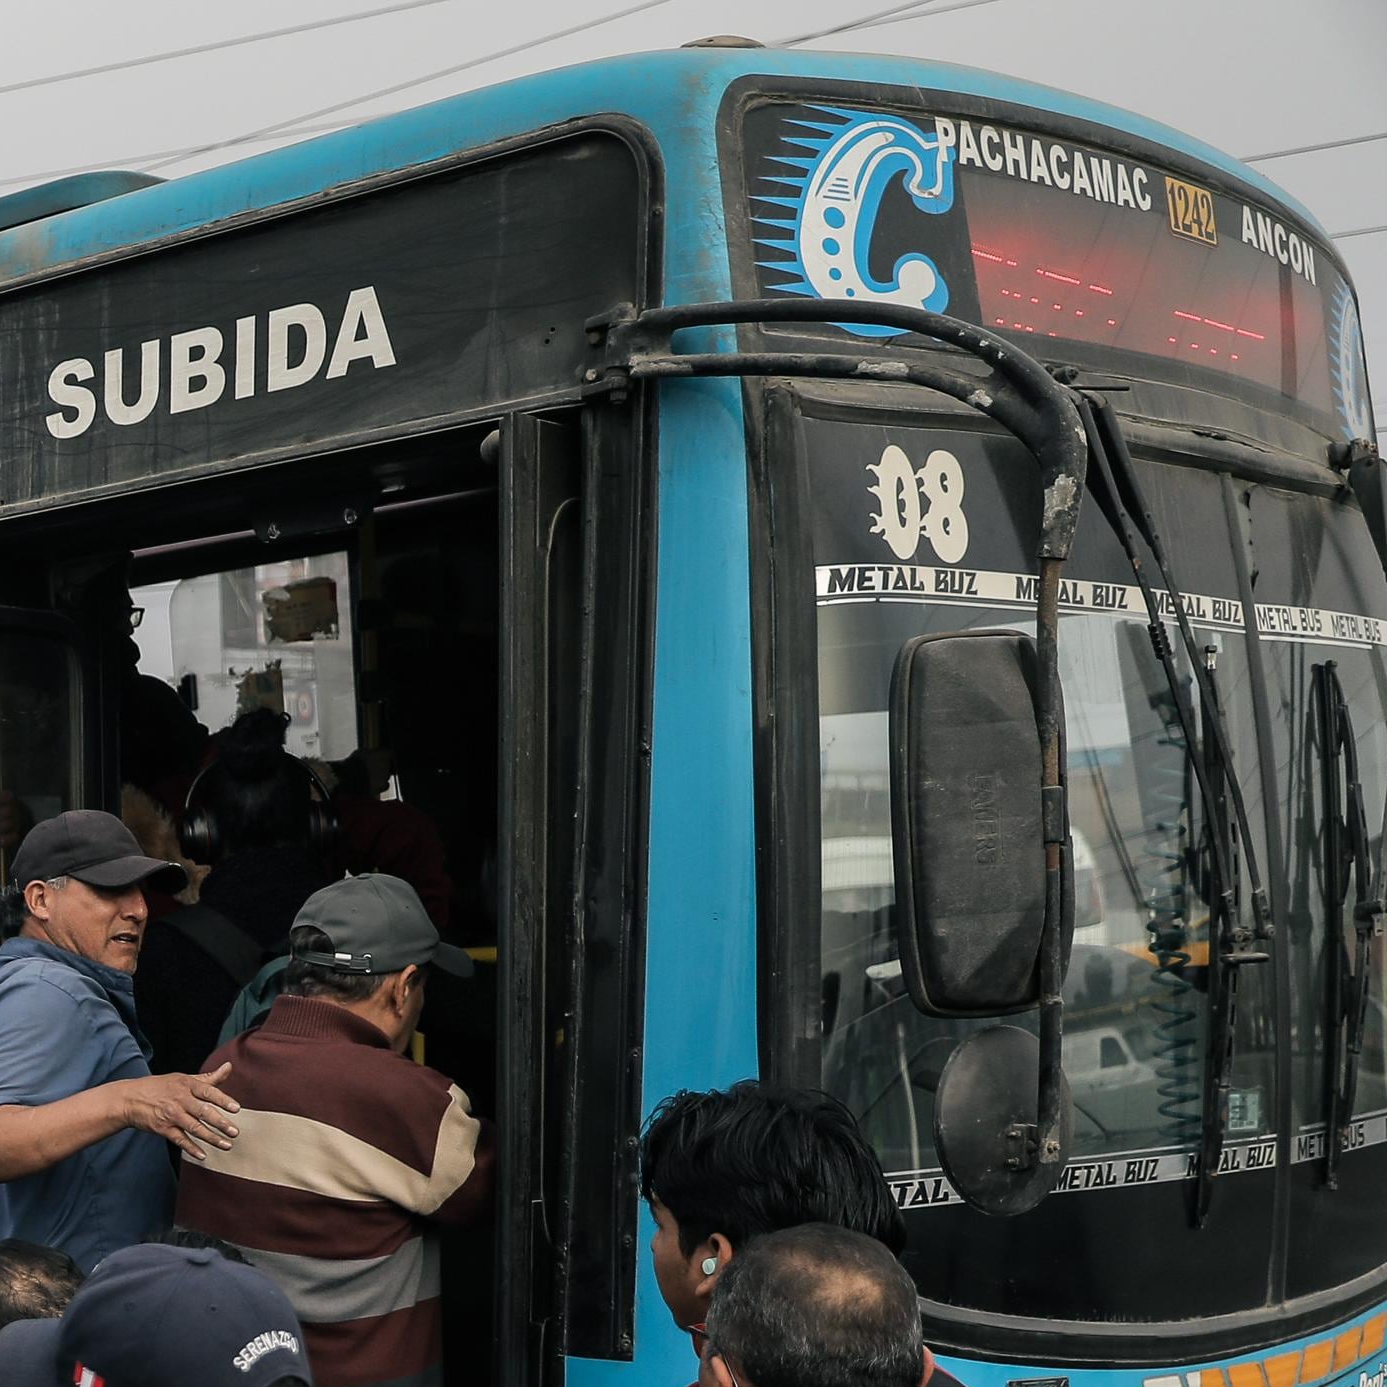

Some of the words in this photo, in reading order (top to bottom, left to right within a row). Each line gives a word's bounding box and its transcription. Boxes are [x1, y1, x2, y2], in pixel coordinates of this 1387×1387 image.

[935, 116, 1153, 212] PACHACAMAC
[1168, 182, 1216, 240] 1242
[1242, 205, 1318, 287] ANCON
[46, 286, 397, 440] SUBIDA
[866, 445, 970, 564] 08
[827, 566, 924, 594] METAL
[934, 569, 978, 596] BUZ
[1015, 576, 1084, 606] MEAL
[1091, 584, 1129, 609] BUZ
[1212, 600, 1241, 623] BUZ
[1257, 605, 1297, 631] METAL
[1300, 609, 1323, 632] BUS
[1331, 615, 1363, 640] METAL
[1124, 1158, 1160, 1184] BUZ
[1246, 1144, 1275, 1169] BUZ
[1298, 1132, 1325, 1161] MET
[890, 1177, 949, 1207] TAL
[233, 1330, 299, 1373] SERENAZGO
